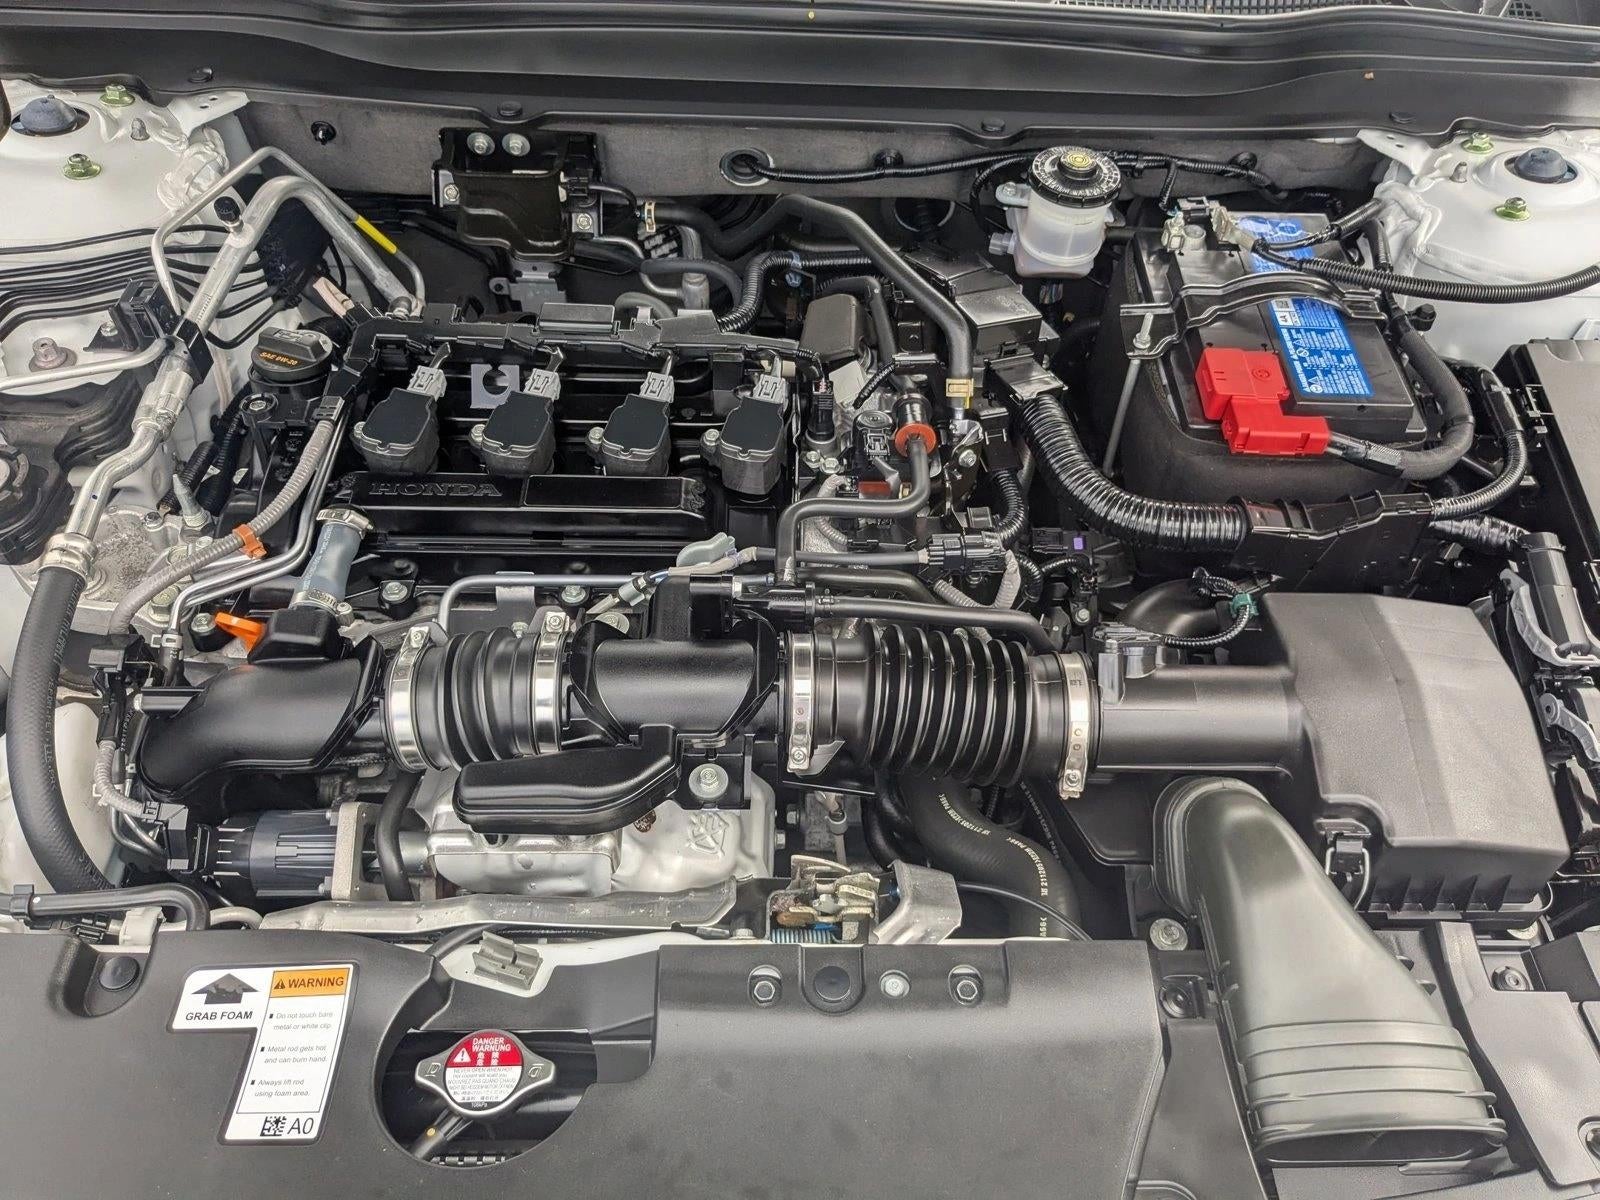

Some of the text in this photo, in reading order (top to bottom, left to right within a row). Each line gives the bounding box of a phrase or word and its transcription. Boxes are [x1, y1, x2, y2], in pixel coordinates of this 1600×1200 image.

[260, 352, 298, 366] SAE 0W-20
[369, 483, 502, 497] HONDA
[288, 976, 344, 988] WARNING
[185, 1011, 253, 1021] GRAB FOAM
[472, 1044, 512, 1052] WARNUNG
[287, 1117, 314, 1135] A0
